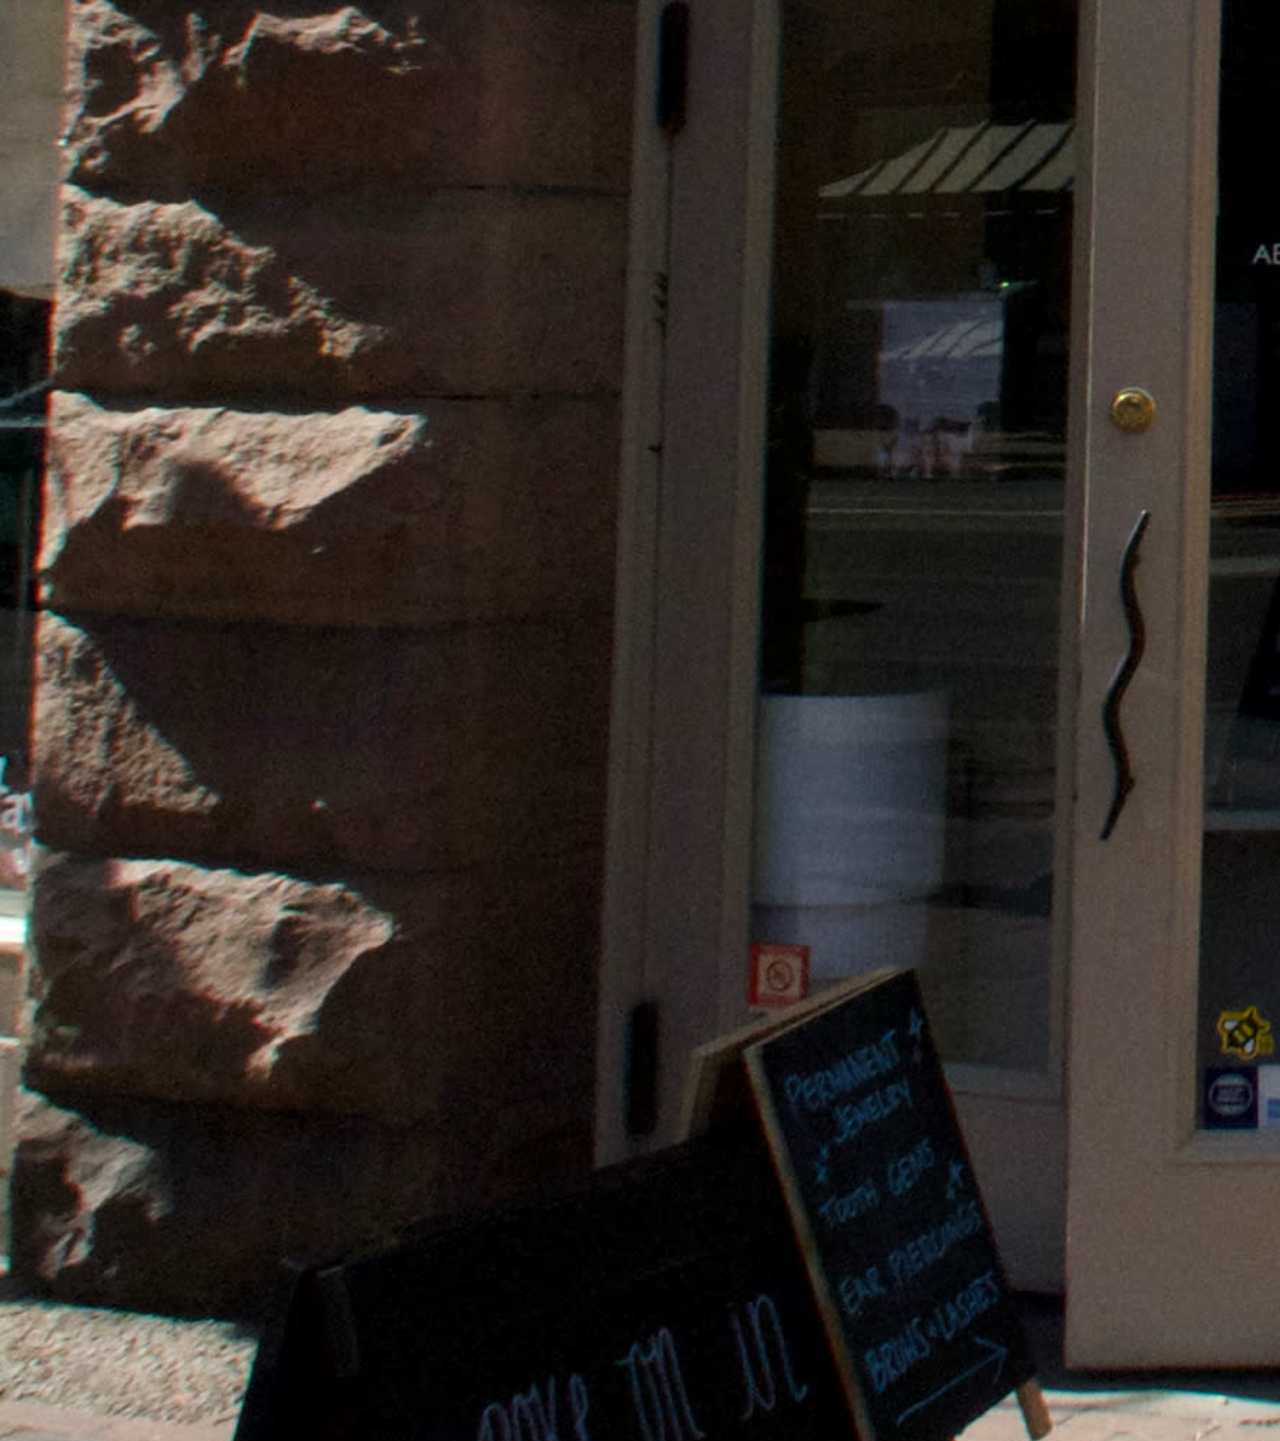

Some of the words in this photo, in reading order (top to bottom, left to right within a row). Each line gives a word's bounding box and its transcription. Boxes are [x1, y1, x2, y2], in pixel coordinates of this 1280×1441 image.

[783, 1027, 901, 1110] PERMANENT
[831, 1077, 913, 1142] JEWELRY
[818, 1177, 882, 1228] TOOTH
[885, 1135, 938, 1199] GEMS
[838, 1273, 886, 1317] EAR
